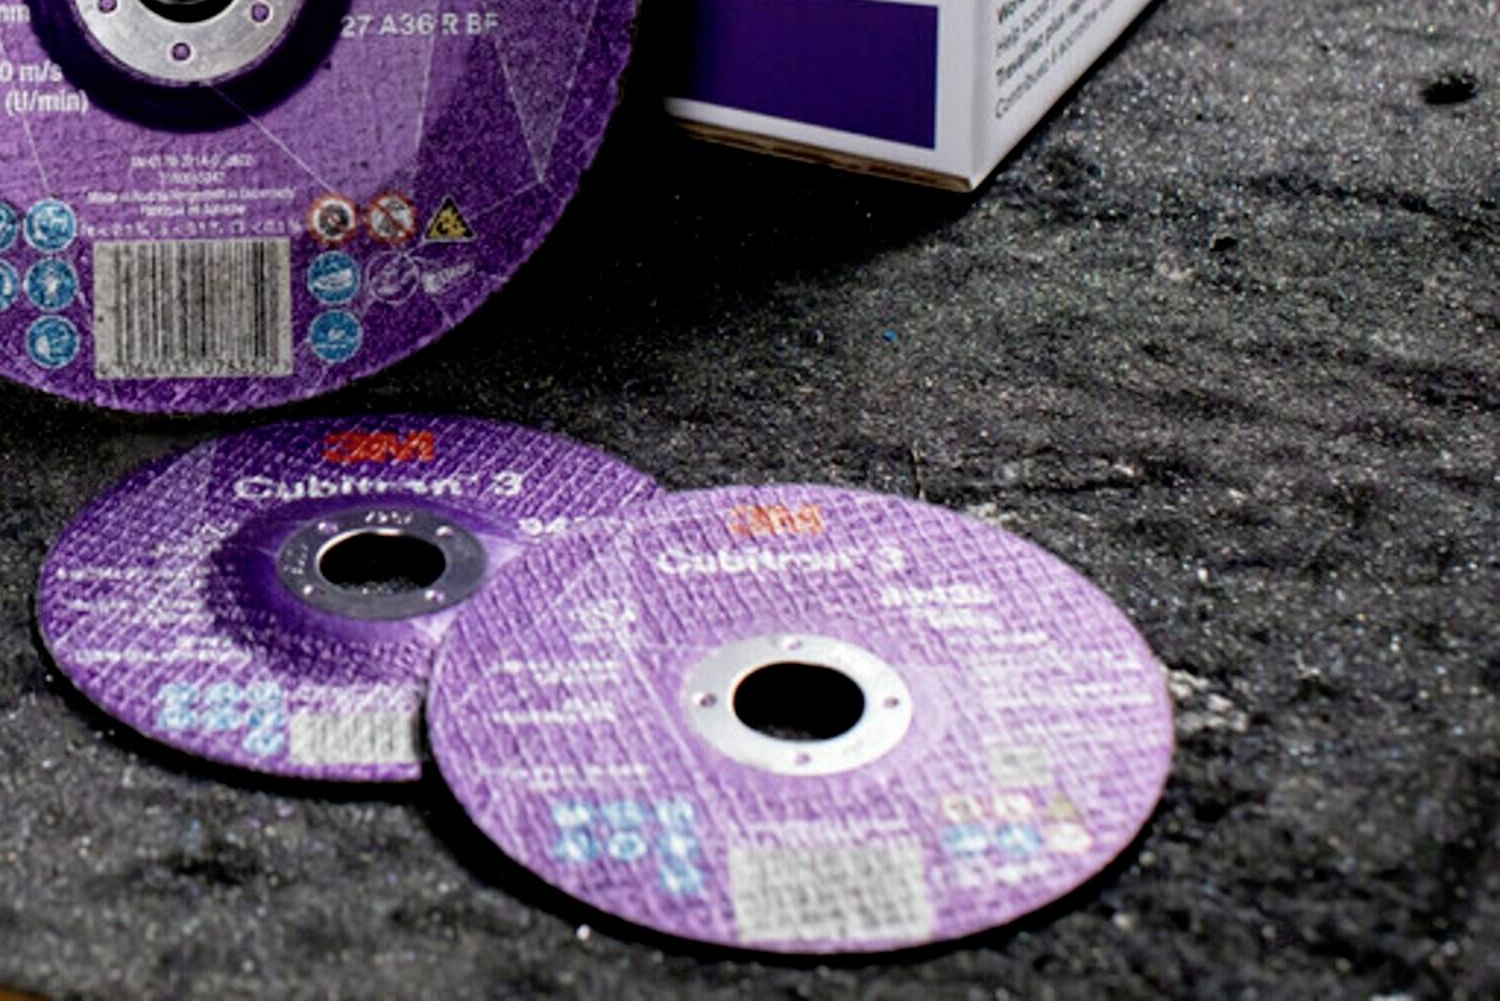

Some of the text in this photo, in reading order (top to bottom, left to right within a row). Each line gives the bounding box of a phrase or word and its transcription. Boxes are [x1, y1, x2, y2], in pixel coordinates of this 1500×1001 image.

[5, 88, 89, 116] (U/min)
[325, 431, 435, 462] 3M
[494, 472, 524, 496] 3
[733, 504, 824, 537] 3M
